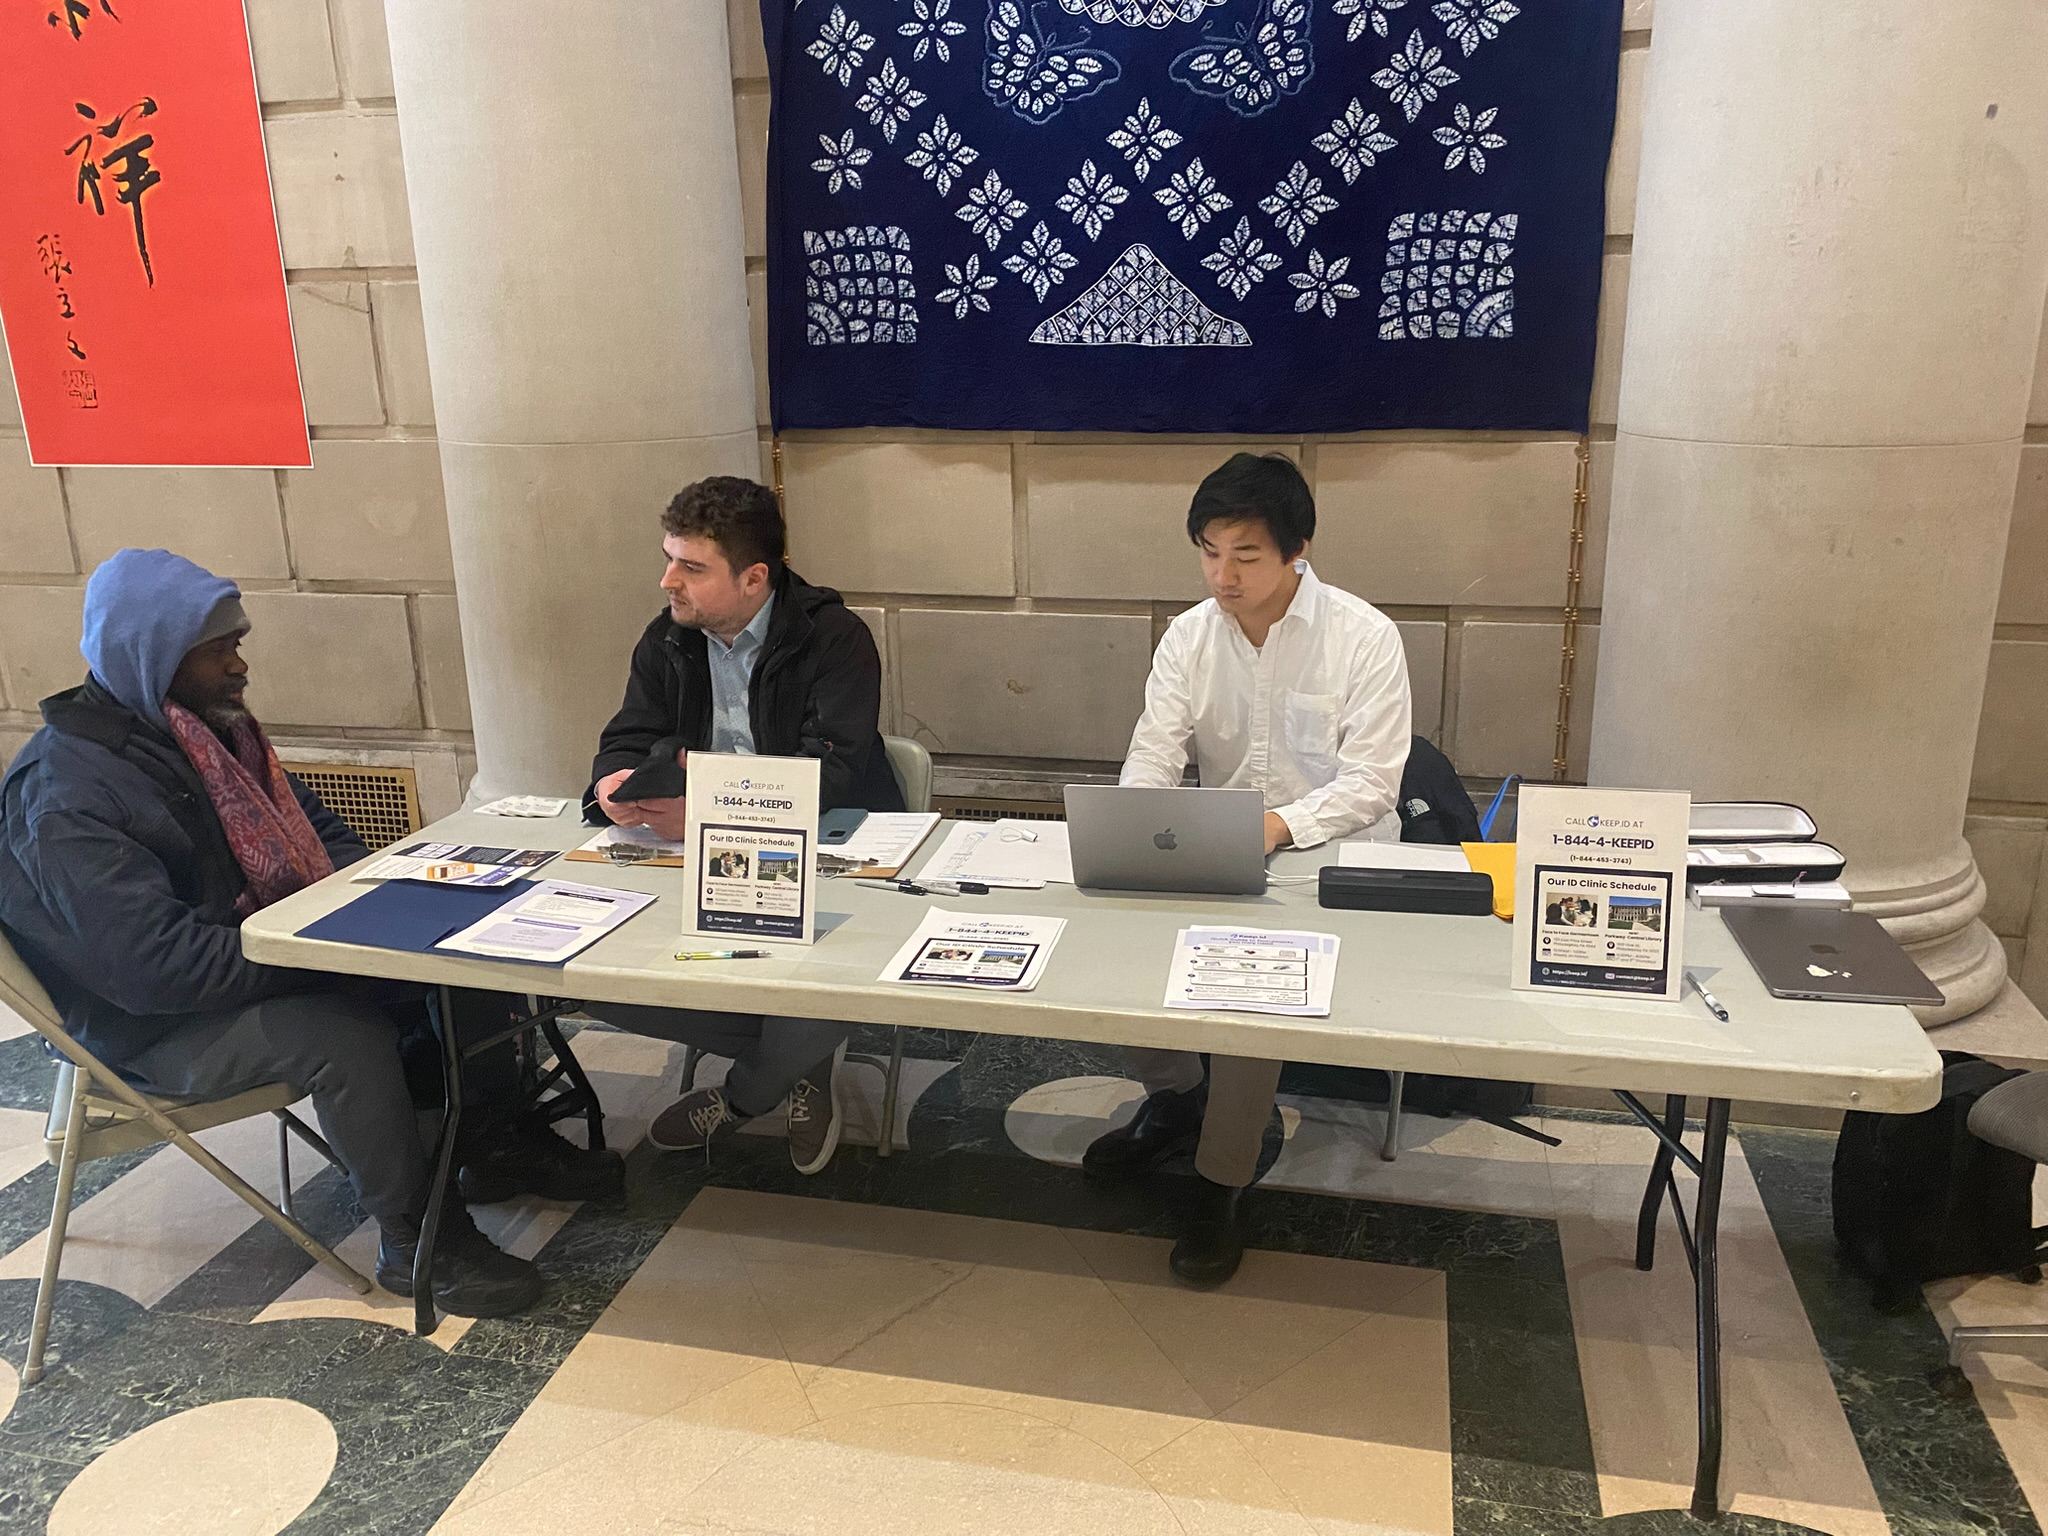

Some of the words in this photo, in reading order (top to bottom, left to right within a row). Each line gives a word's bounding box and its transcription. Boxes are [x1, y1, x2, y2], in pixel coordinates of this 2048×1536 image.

[724, 780, 740, 789] CALL
[714, 795, 793, 810] 1-844-4-KEEPID
[1565, 817, 1586, 826] CALL
[735, 836, 757, 845] Clinic
[758, 838, 795, 847] Schedule
[1552, 834, 1654, 850] 1-844-4-KEEPID
[1570, 854, 1632, 865] (1-844-453-3743)
[1547, 878, 1566, 887] Our
[1568, 879, 1578, 887] ID
[1579, 879, 1608, 889] Clinic
[1610, 881, 1657, 892] Schedule
[947, 927, 1030, 937] 1-844-4-KEEPID
